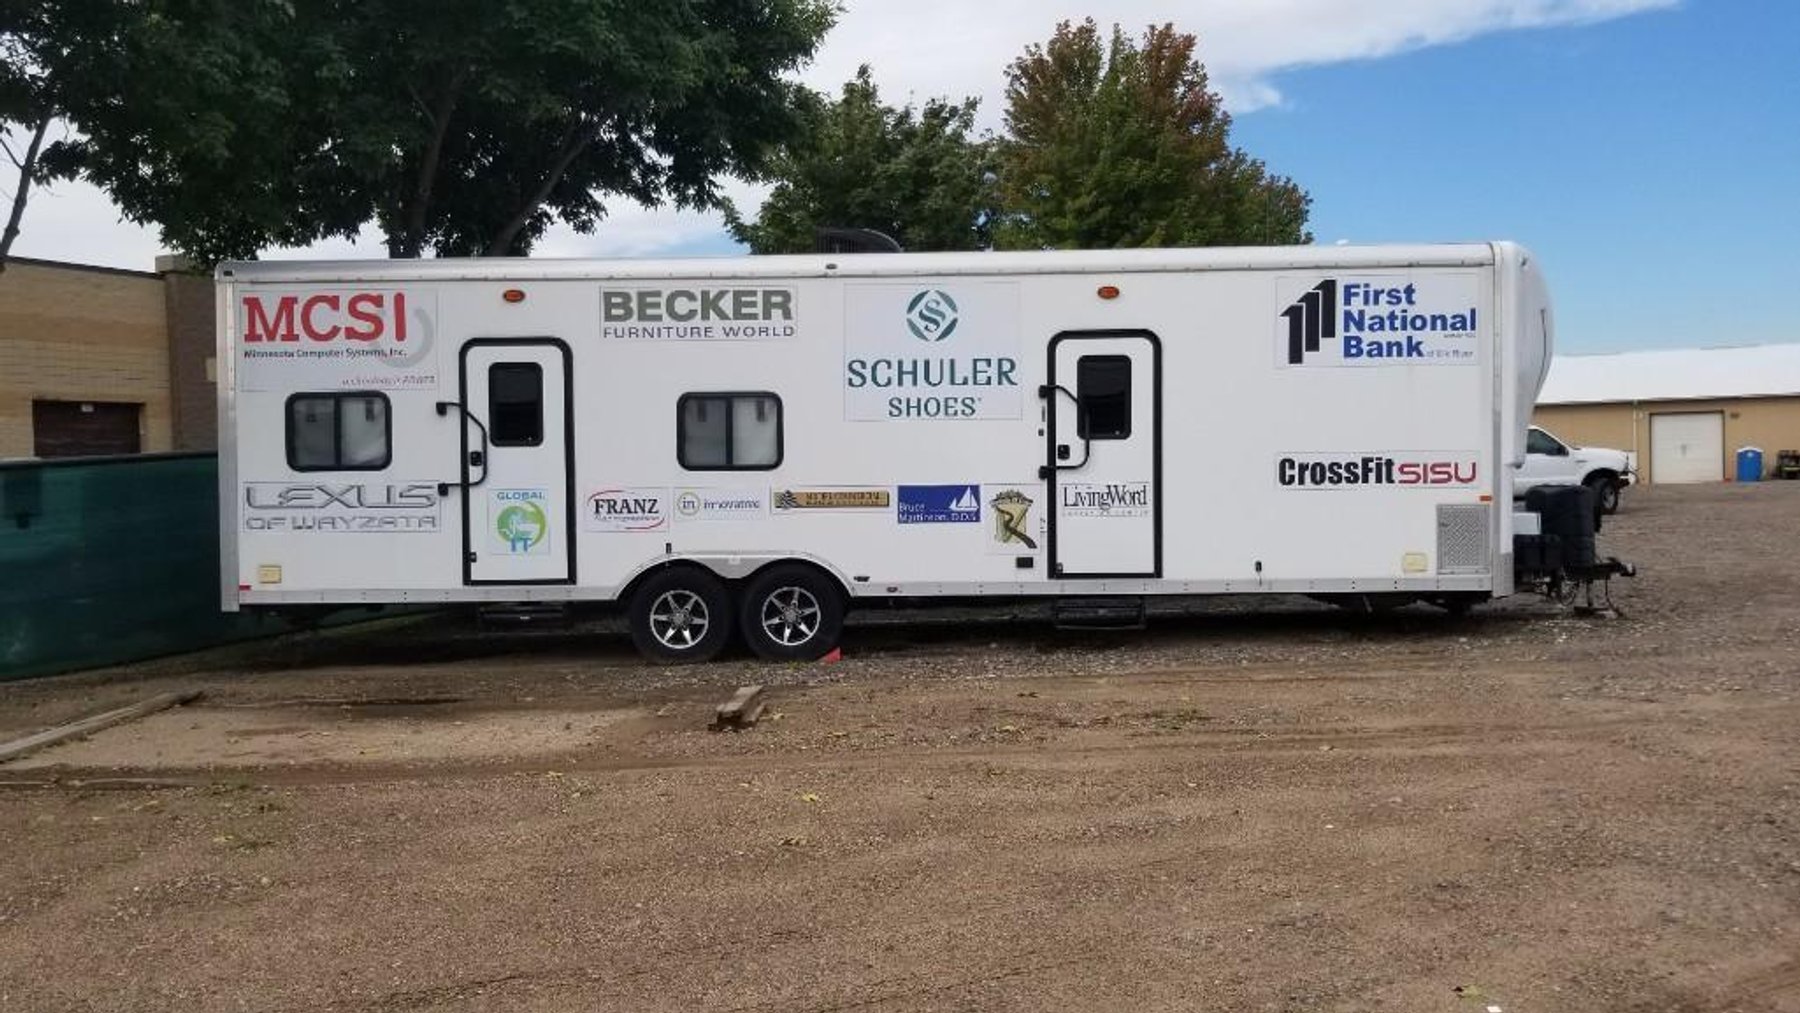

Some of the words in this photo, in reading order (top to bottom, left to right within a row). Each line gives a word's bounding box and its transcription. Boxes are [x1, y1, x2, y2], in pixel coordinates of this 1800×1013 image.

[603, 289, 792, 322] BECKER
[1343, 283, 1416, 306] First
[242, 292, 407, 342] MCSI
[1343, 308, 1477, 333] National
[603, 326, 715, 338] FURNITURE
[722, 325, 794, 337] WORLD
[244, 350, 294, 358] Minnesota
[297, 349, 343, 359] Computer
[1343, 335, 1424, 358] Bank
[848, 357, 1018, 388] SCHULER
[888, 396, 976, 417] SHOES
[1278, 457, 1395, 486] CrossFit
[1398, 462, 1477, 484] SISU
[246, 484, 435, 508] LEXUS
[497, 491, 545, 500] GLOBAL
[594, 498, 659, 515] FRANZ
[899, 502, 925, 512] Bruce
[1063, 484, 1147, 510] LivingWord
[246, 516, 287, 529] OF
[292, 516, 436, 529] WAYZATA
[510, 537, 531, 552] IT
